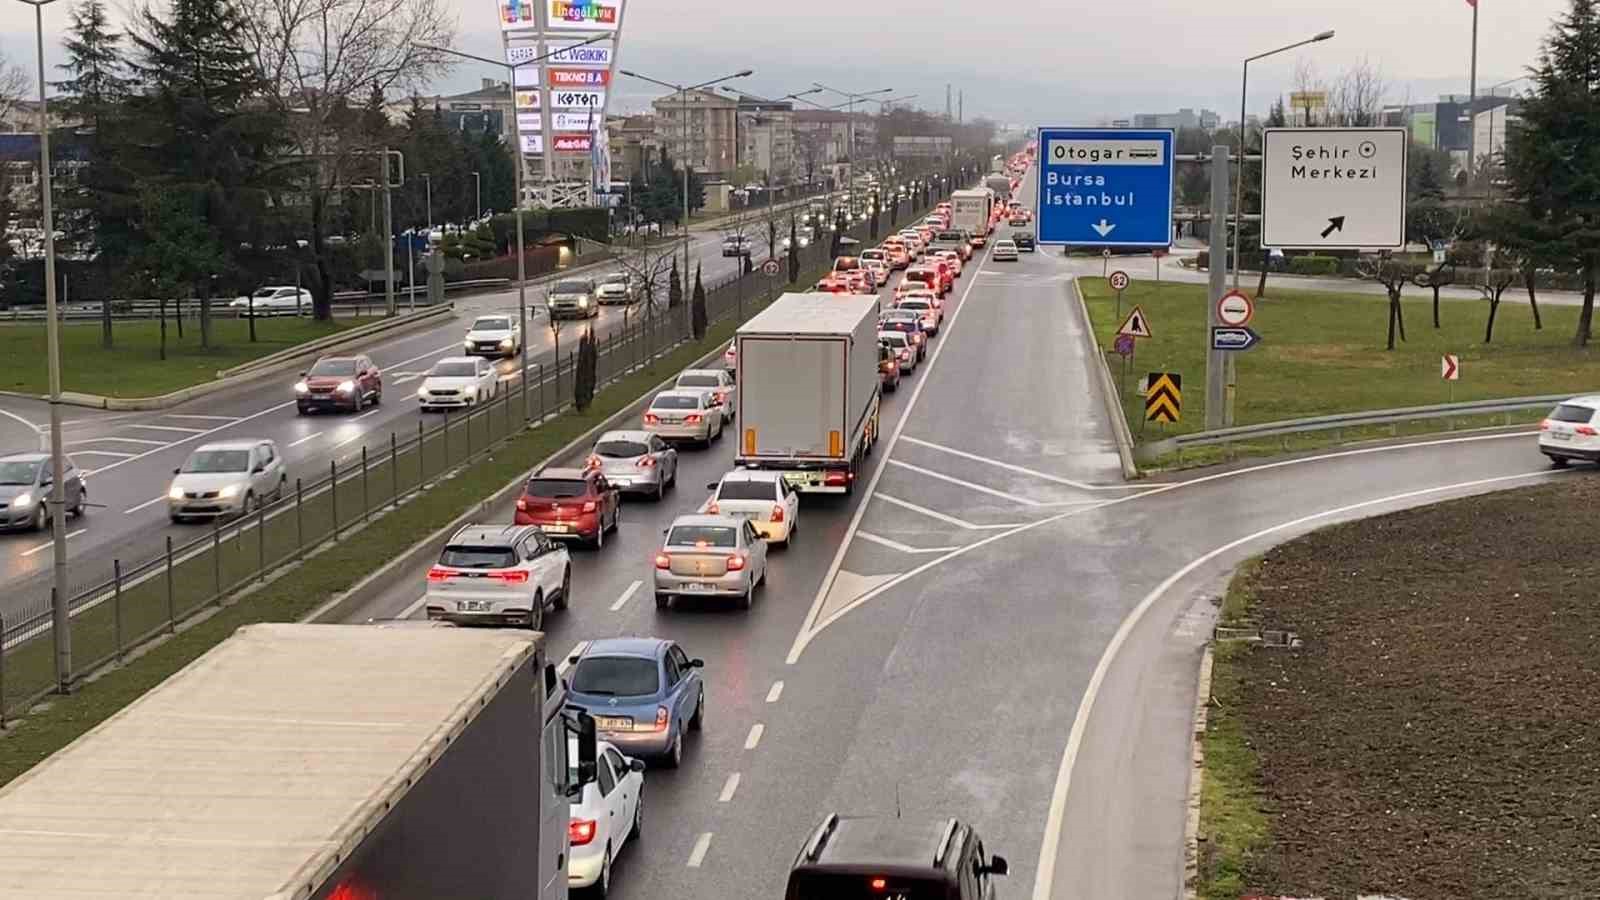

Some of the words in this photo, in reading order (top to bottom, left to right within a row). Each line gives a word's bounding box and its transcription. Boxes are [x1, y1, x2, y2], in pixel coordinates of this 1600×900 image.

[554, 48, 567, 60] LC
[1054, 145, 1124, 161] Otogar
[1292, 145, 1350, 160] Şehir
[1047, 172, 1105, 186] Bursa
[1291, 165, 1376, 179] Merkezi
[1046, 189, 1133, 206] İstanbul
